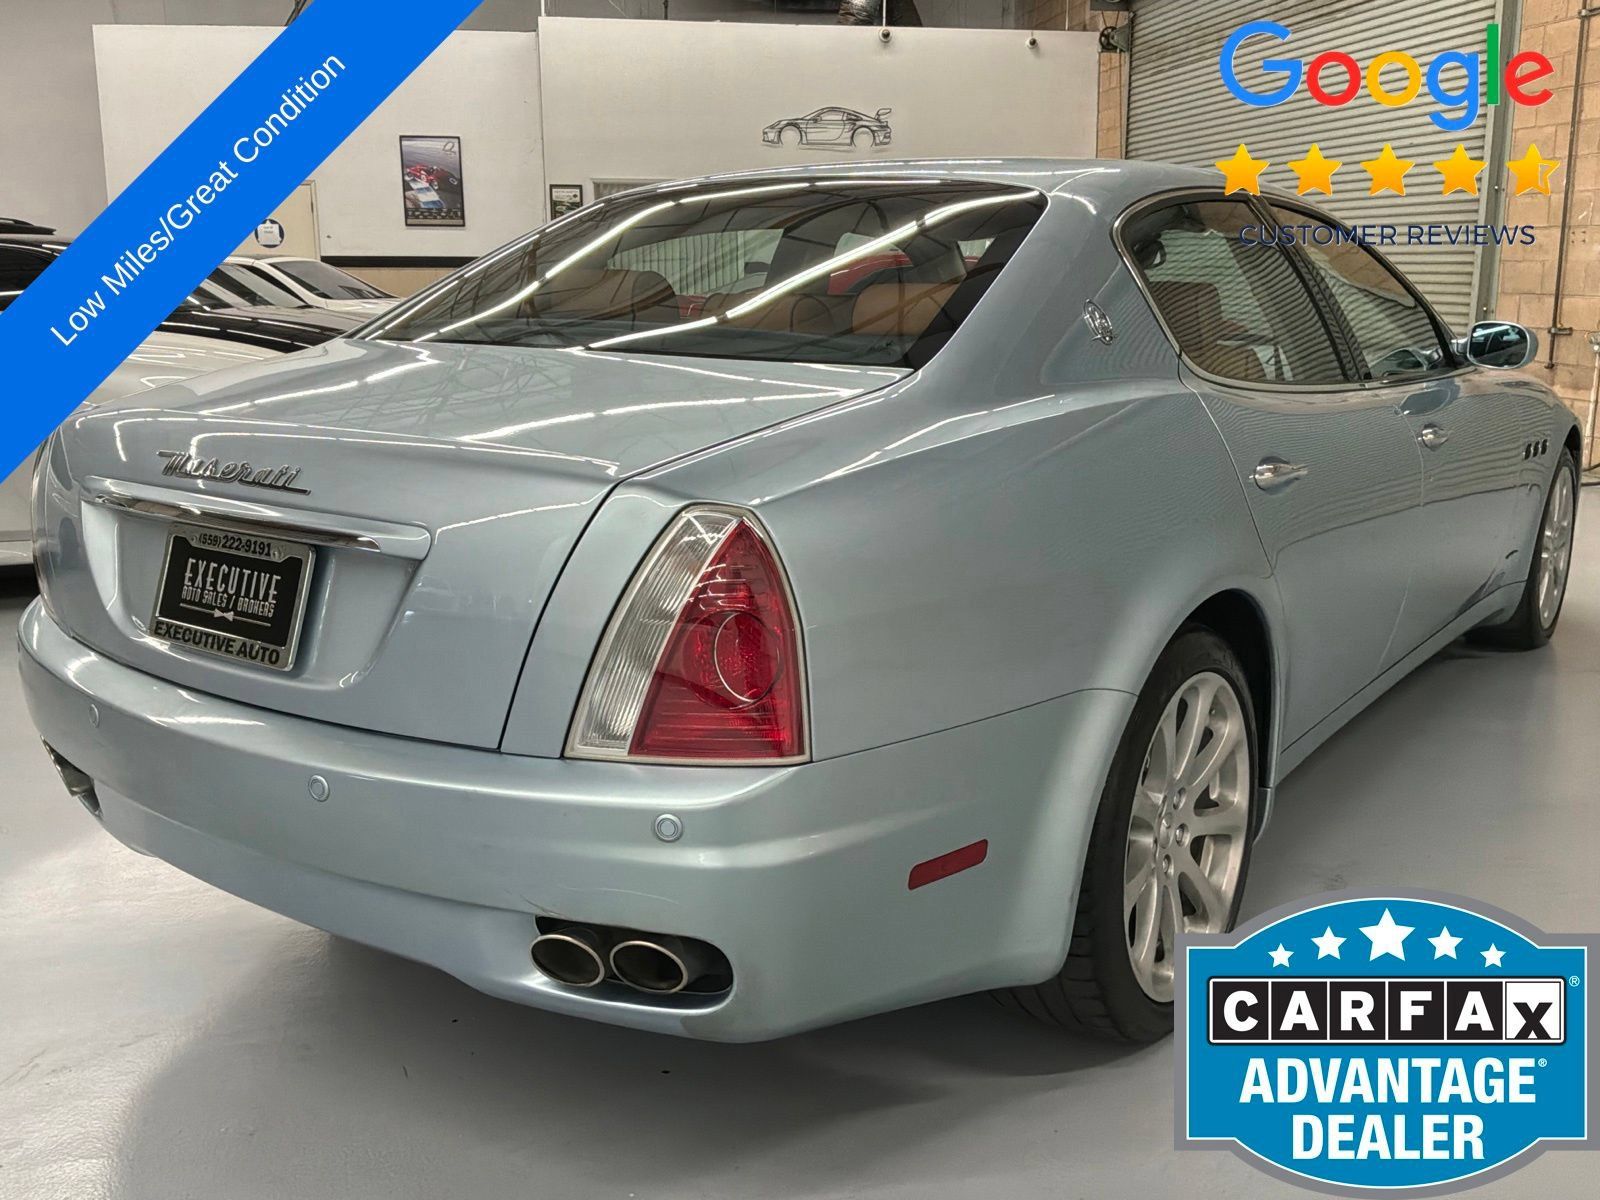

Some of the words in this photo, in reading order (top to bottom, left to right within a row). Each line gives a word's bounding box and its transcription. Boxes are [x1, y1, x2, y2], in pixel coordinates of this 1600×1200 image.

[157, 450, 311, 495] Maserati
[181, 585, 201, 602] AUTO
[202, 590, 228, 608] SALES
[237, 597, 275, 618] BROKERS
[184, 558, 281, 604] EXECUTIVE
[153, 622, 236, 655] EXECUTIVE
[235, 641, 280, 665] AUTO
